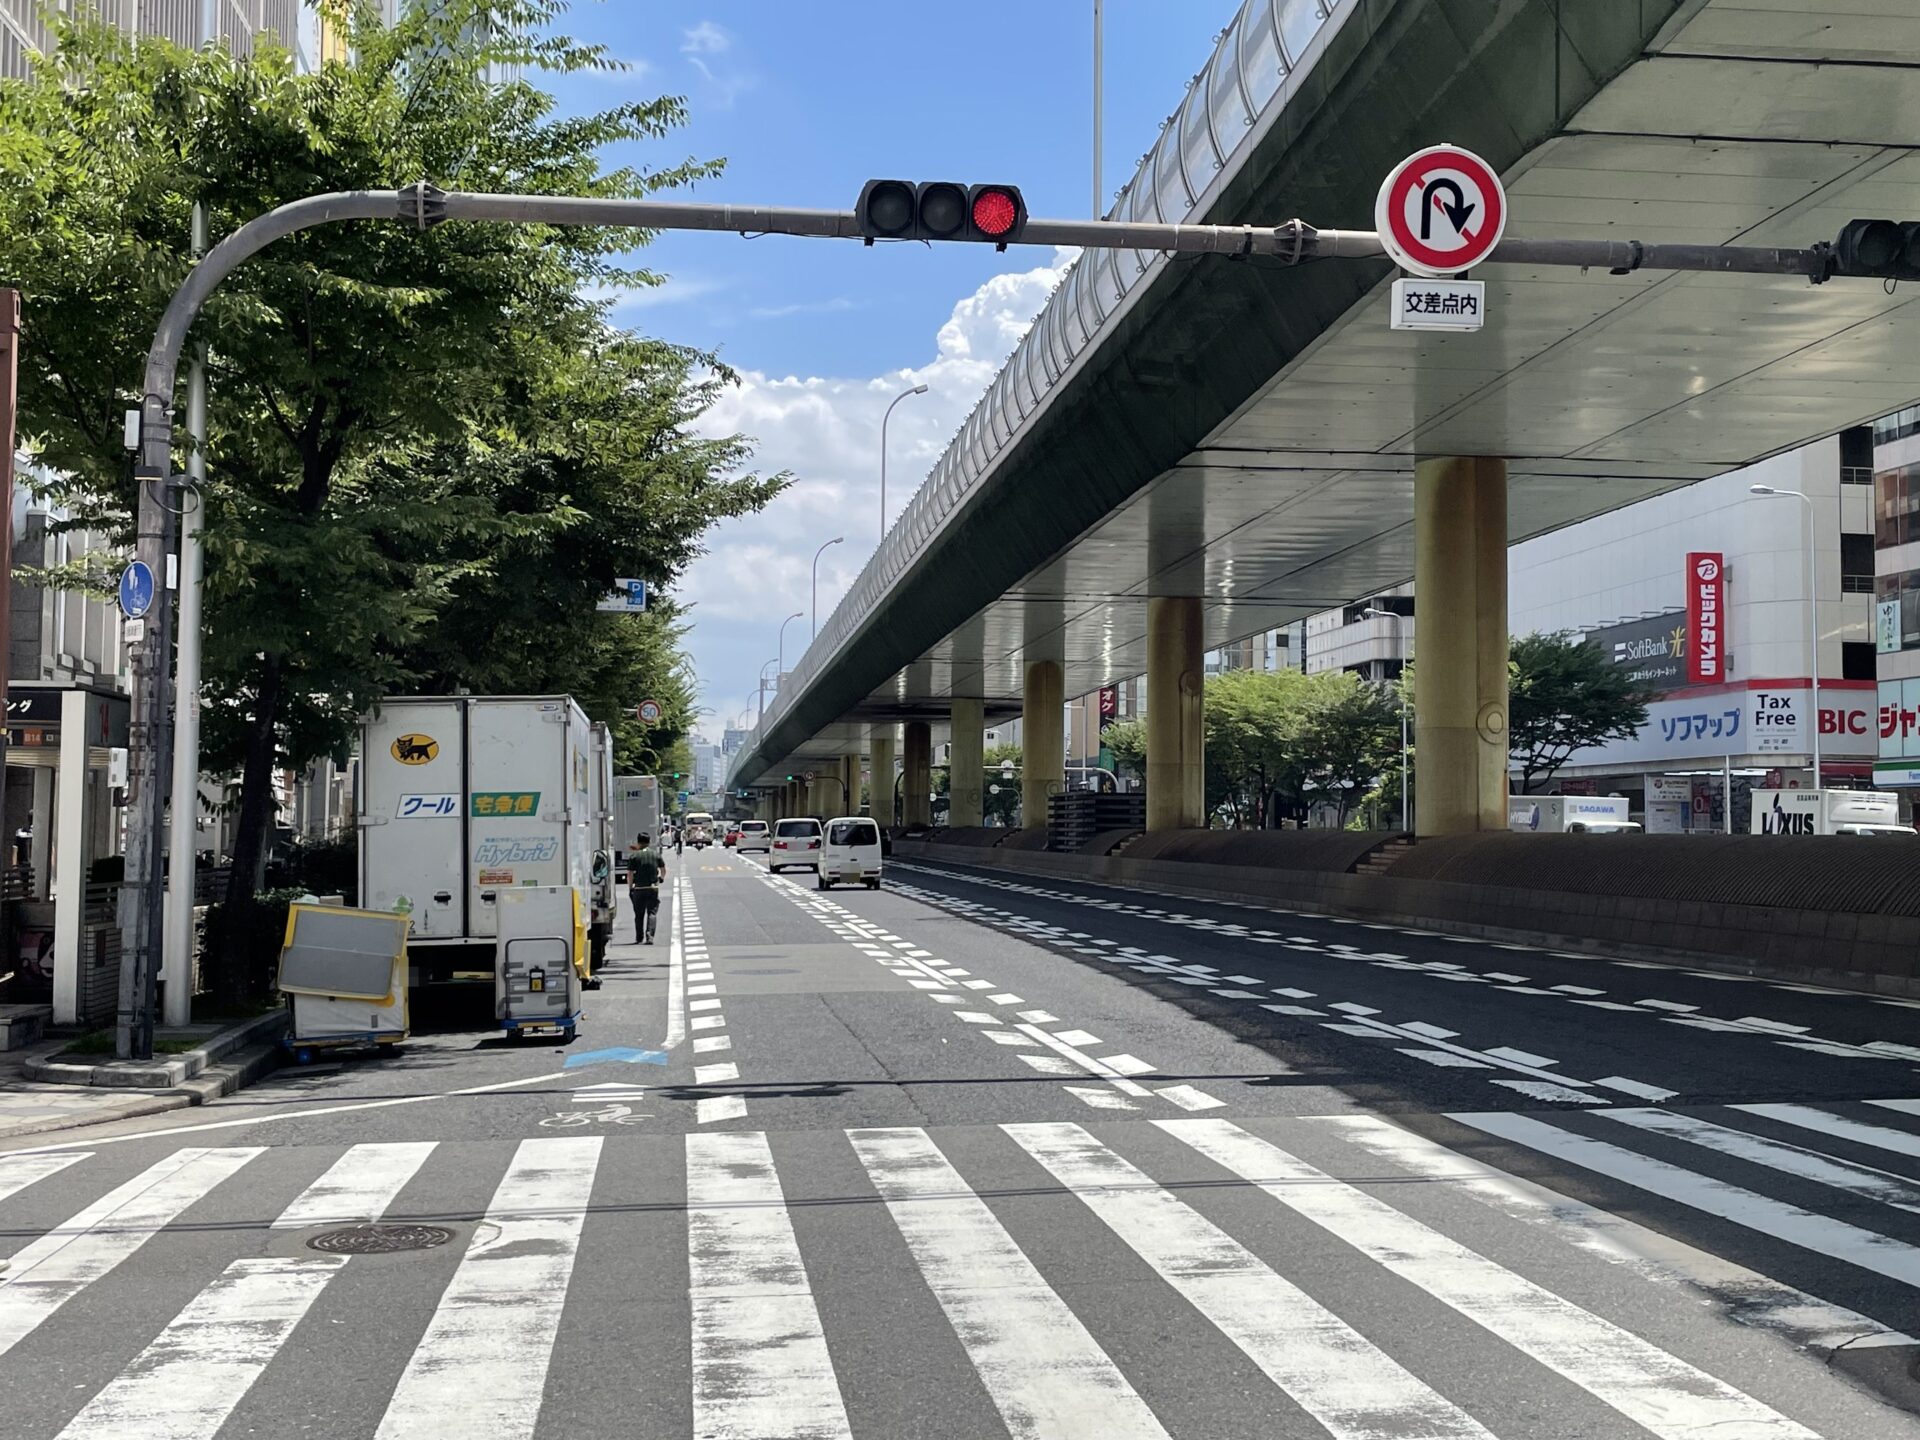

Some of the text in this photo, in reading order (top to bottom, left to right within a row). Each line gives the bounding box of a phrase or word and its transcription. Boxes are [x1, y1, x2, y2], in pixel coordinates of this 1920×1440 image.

[1405, 291, 1477, 315] 交差点内
[632, 583, 641, 592] P
[1700, 584, 1716, 675] ビックカメラ
[1627, 625, 1686, 660] SoftBank 光
[1756, 694, 1791, 709] Tax
[643, 707, 657, 718] 50
[1755, 711, 1796, 726] Free
[1818, 709, 1868, 735] BIC
[1880, 703, 1920, 738] ジャ
[1661, 707, 1741, 742] ソフマップ
[403, 797, 456, 816] クール
[475, 795, 534, 814] 宅急便
[1578, 805, 1615, 814] SAGAWA
[474, 842, 559, 867] Hybrid
